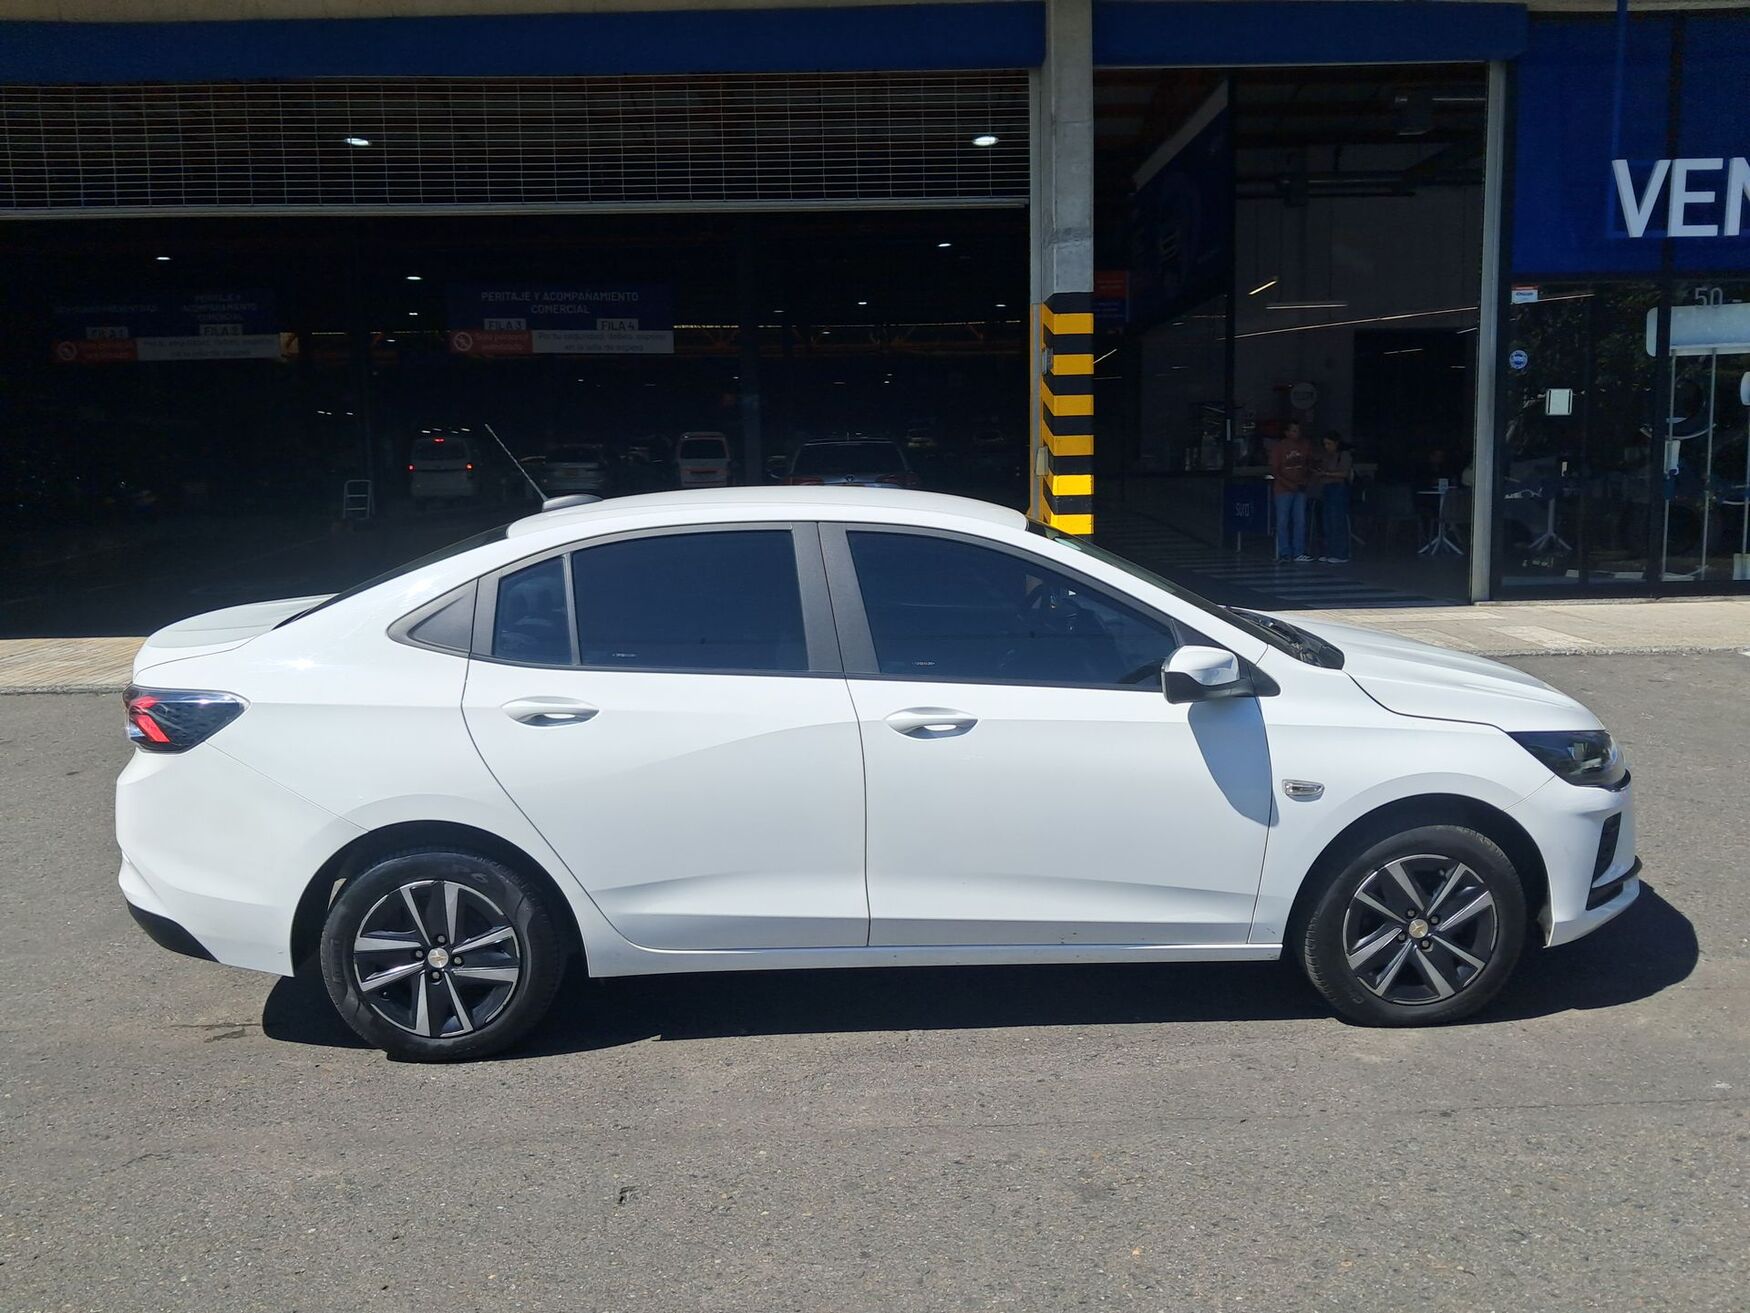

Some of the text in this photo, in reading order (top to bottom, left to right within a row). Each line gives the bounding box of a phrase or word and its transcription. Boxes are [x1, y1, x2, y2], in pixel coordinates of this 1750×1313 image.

[481, 291, 531, 302] PERITAJE
[534, 292, 540, 301] Y
[531, 304, 590, 314] COMERCIAL
[601, 320, 625, 330] FILA
